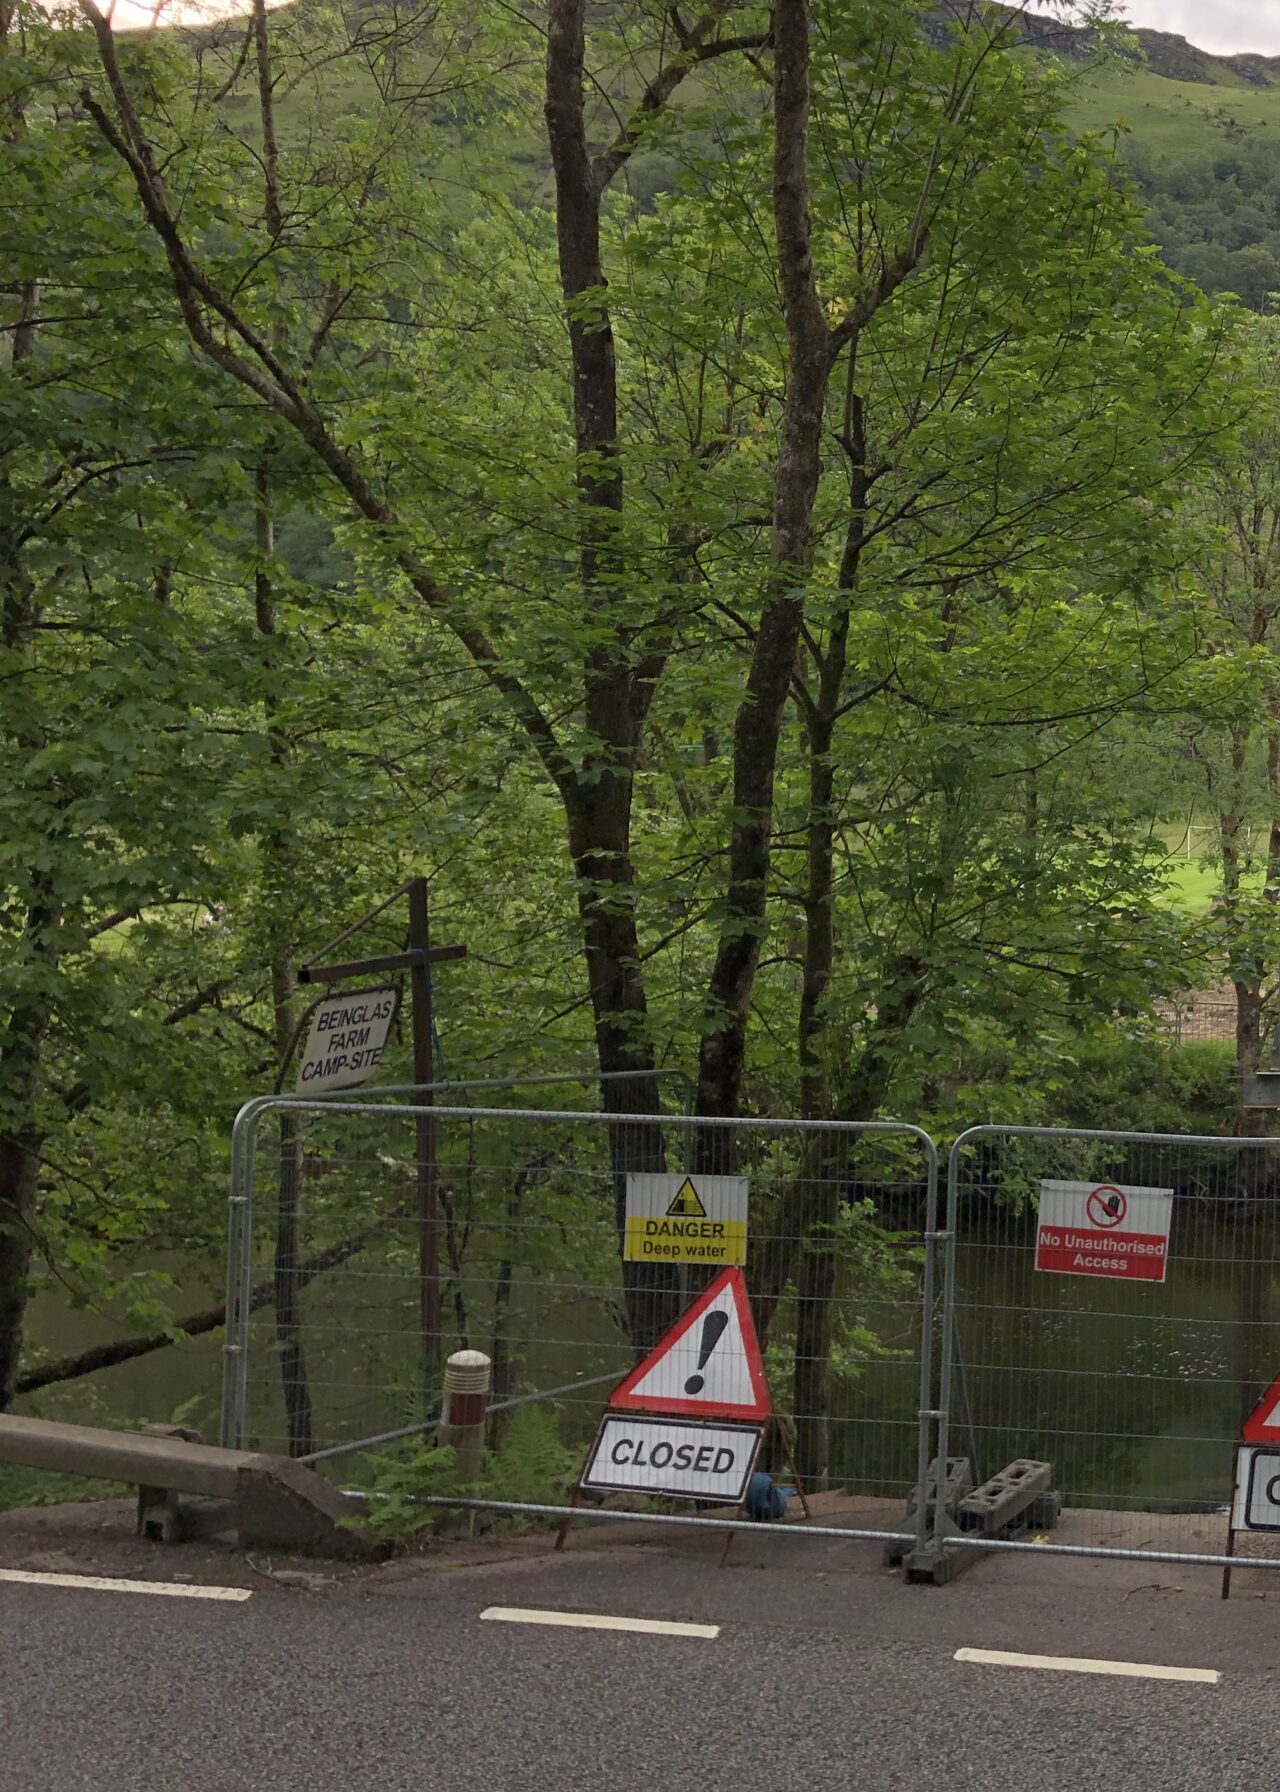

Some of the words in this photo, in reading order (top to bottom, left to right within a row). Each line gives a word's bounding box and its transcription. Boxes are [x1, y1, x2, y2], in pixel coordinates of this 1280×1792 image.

[317, 1000, 392, 1032] BEINGLAS
[327, 1027, 371, 1053] FARM
[302, 1047, 383, 1081] CAMP-SITE
[645, 1220, 725, 1238] DANGER
[643, 1241, 680, 1258] Deep
[685, 1244, 726, 1257] water
[1040, 1232, 1060, 1247] No
[1065, 1234, 1165, 1256] Unauthorised
[1073, 1253, 1128, 1270] Access
[611, 1438, 735, 1474] CLOSED
